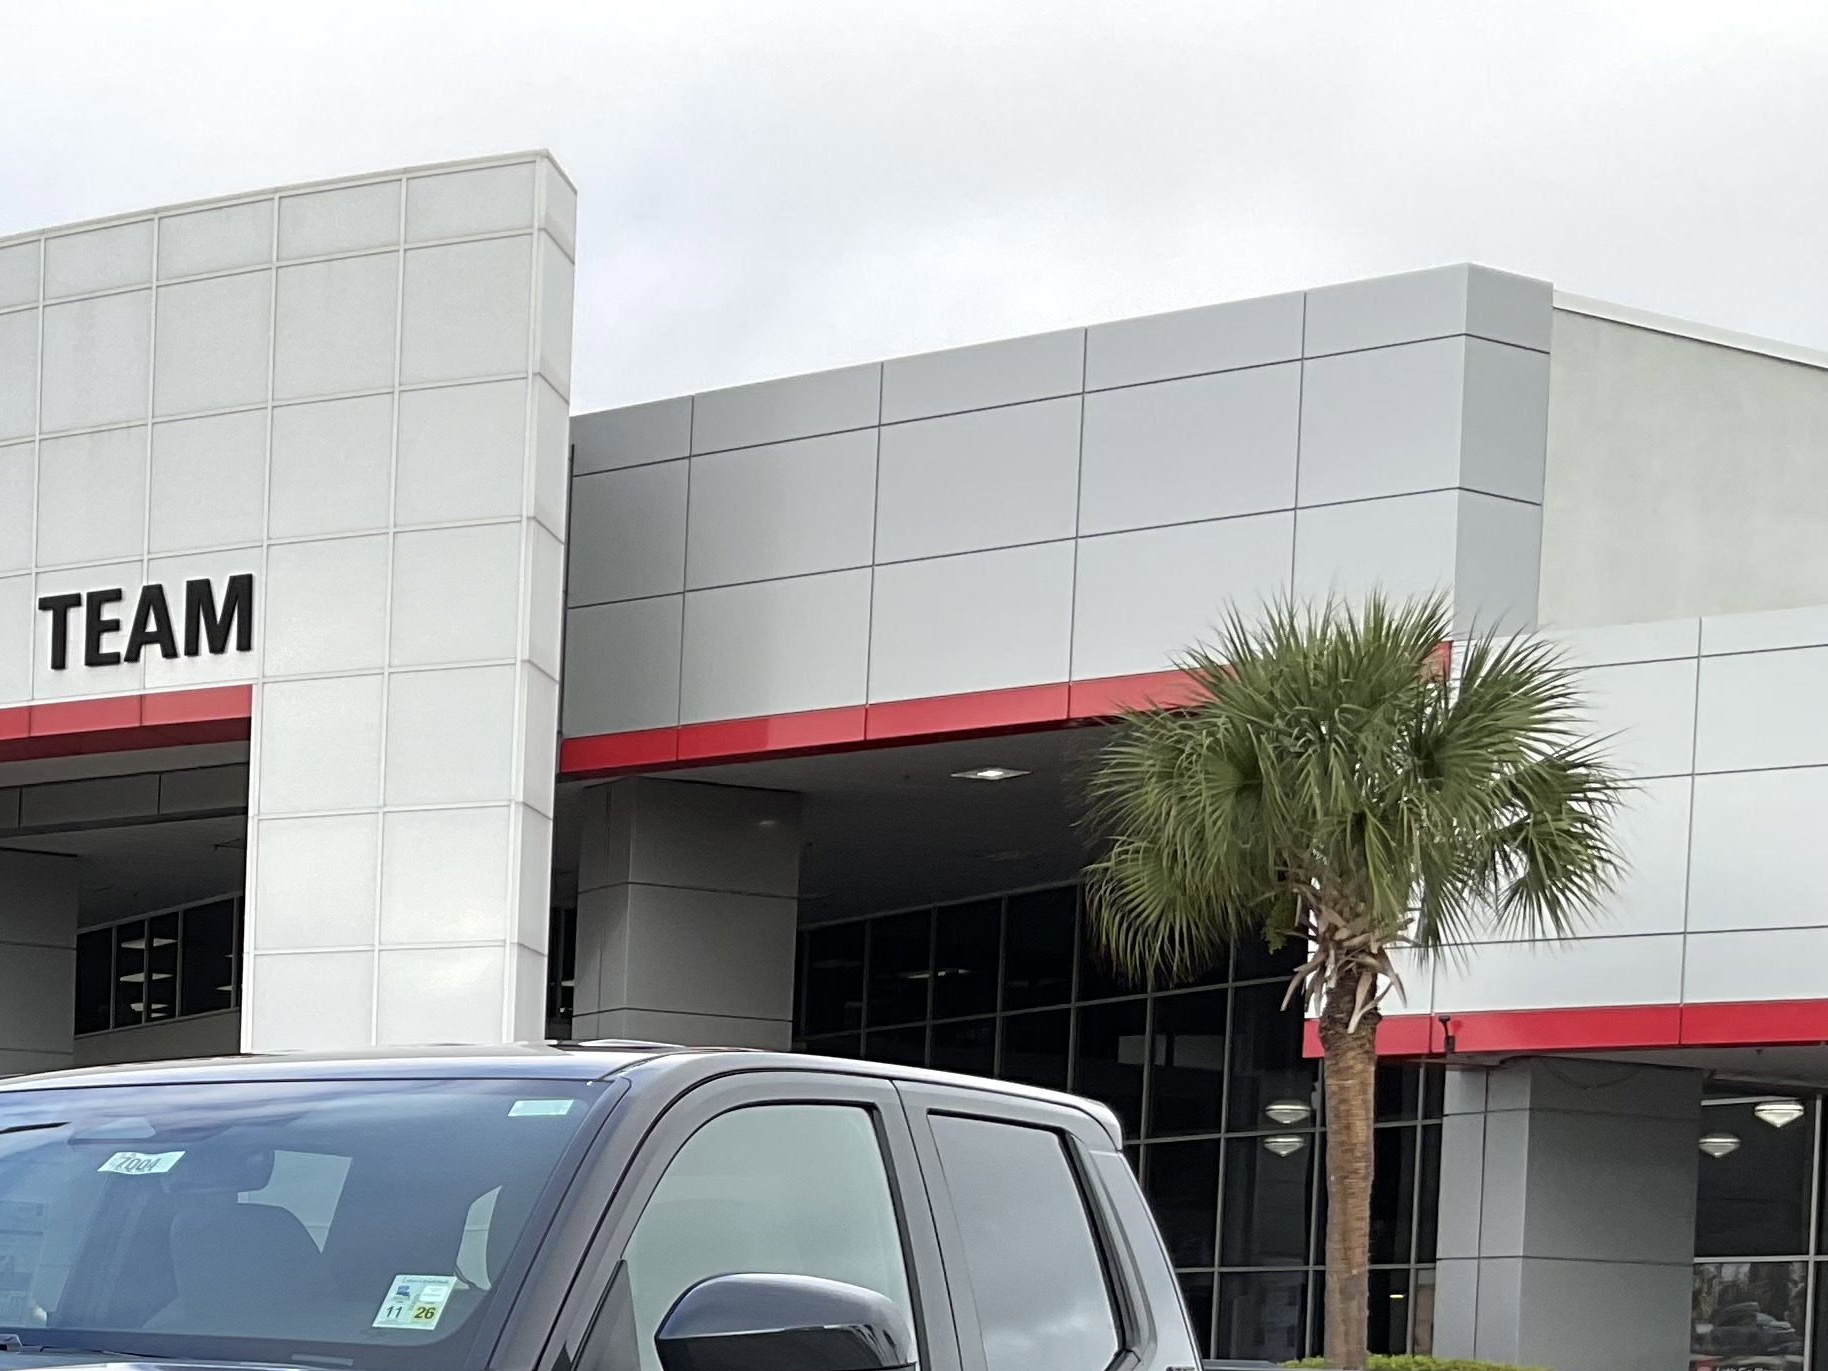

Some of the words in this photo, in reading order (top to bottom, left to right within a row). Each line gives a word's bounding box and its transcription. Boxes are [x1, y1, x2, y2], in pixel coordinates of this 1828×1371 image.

[38, 573, 254, 671] TEAM
[386, 1306, 403, 1318] 11
[414, 1307, 436, 1319] 26
